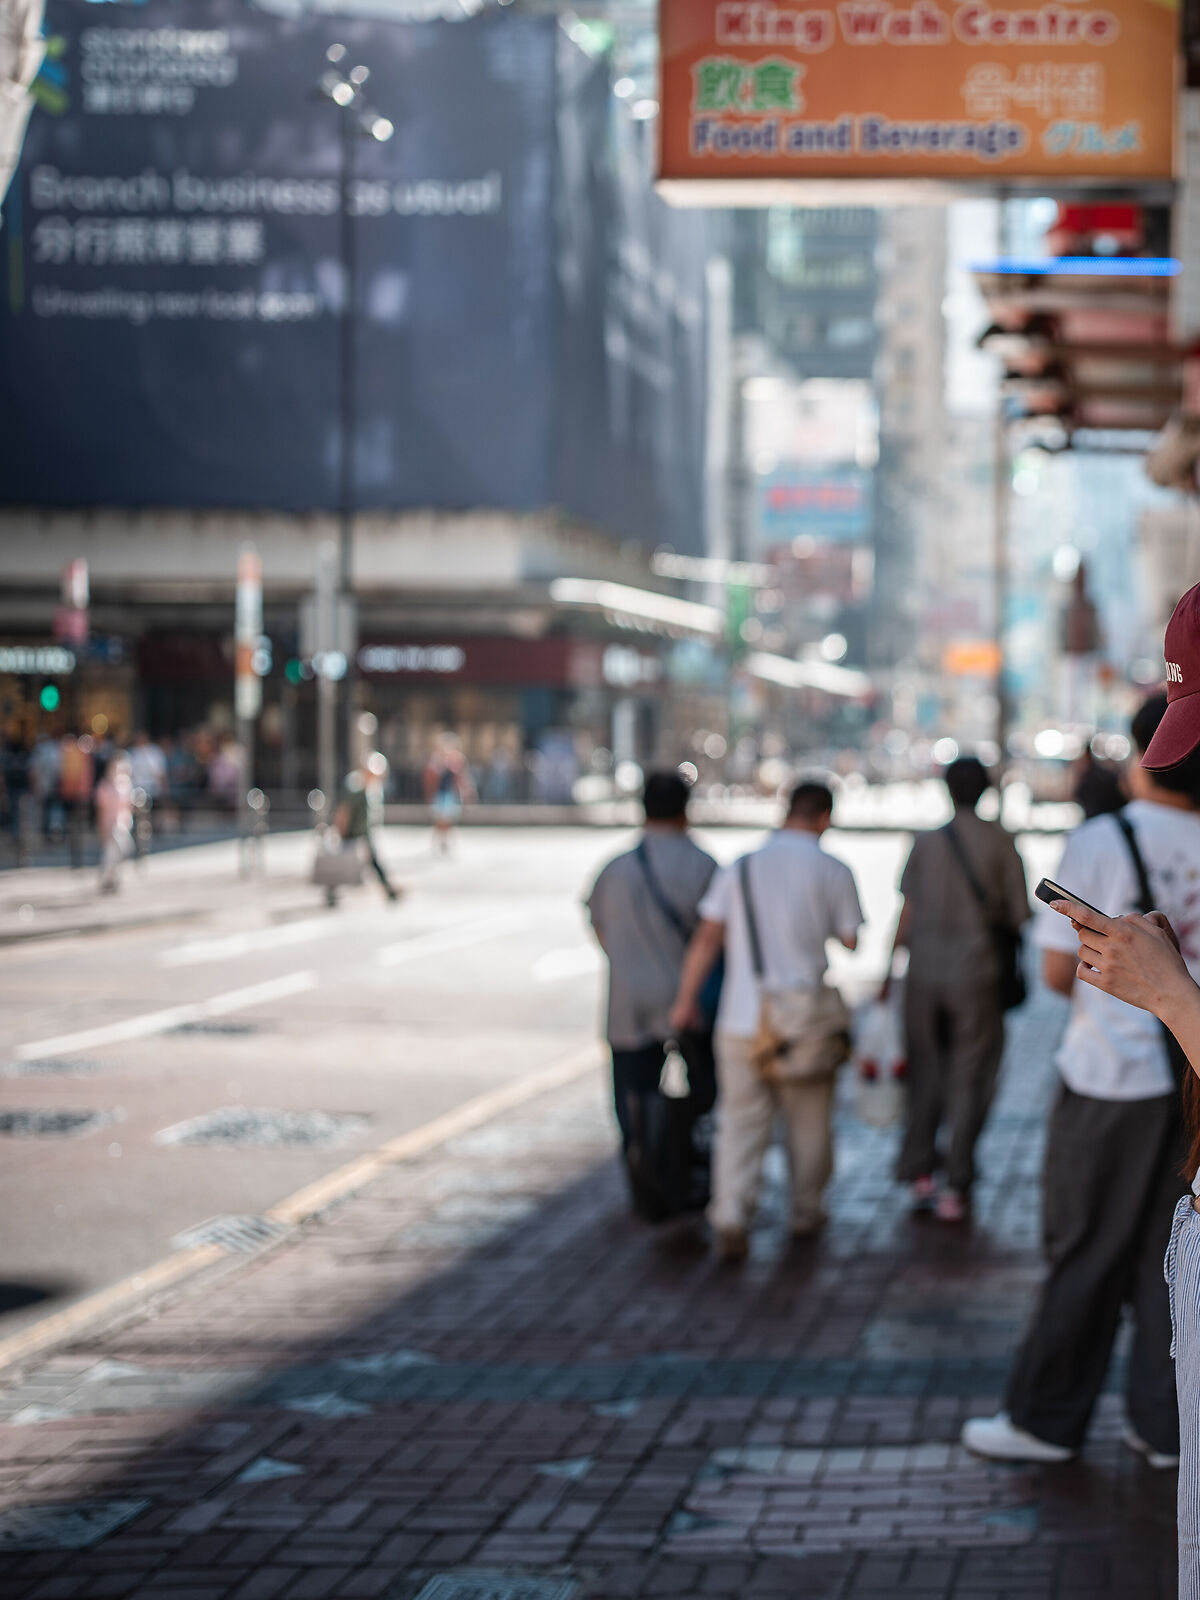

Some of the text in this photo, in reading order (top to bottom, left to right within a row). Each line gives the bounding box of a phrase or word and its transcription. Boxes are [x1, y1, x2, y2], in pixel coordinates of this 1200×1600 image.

[718, 2, 1117, 52] King Wah Centre
[692, 56, 804, 114] 飲食
[690, 115, 1027, 162] Food and Beverage
[30, 165, 170, 212] Branch
[172, 166, 341, 214] business
[392, 168, 502, 216] usual
